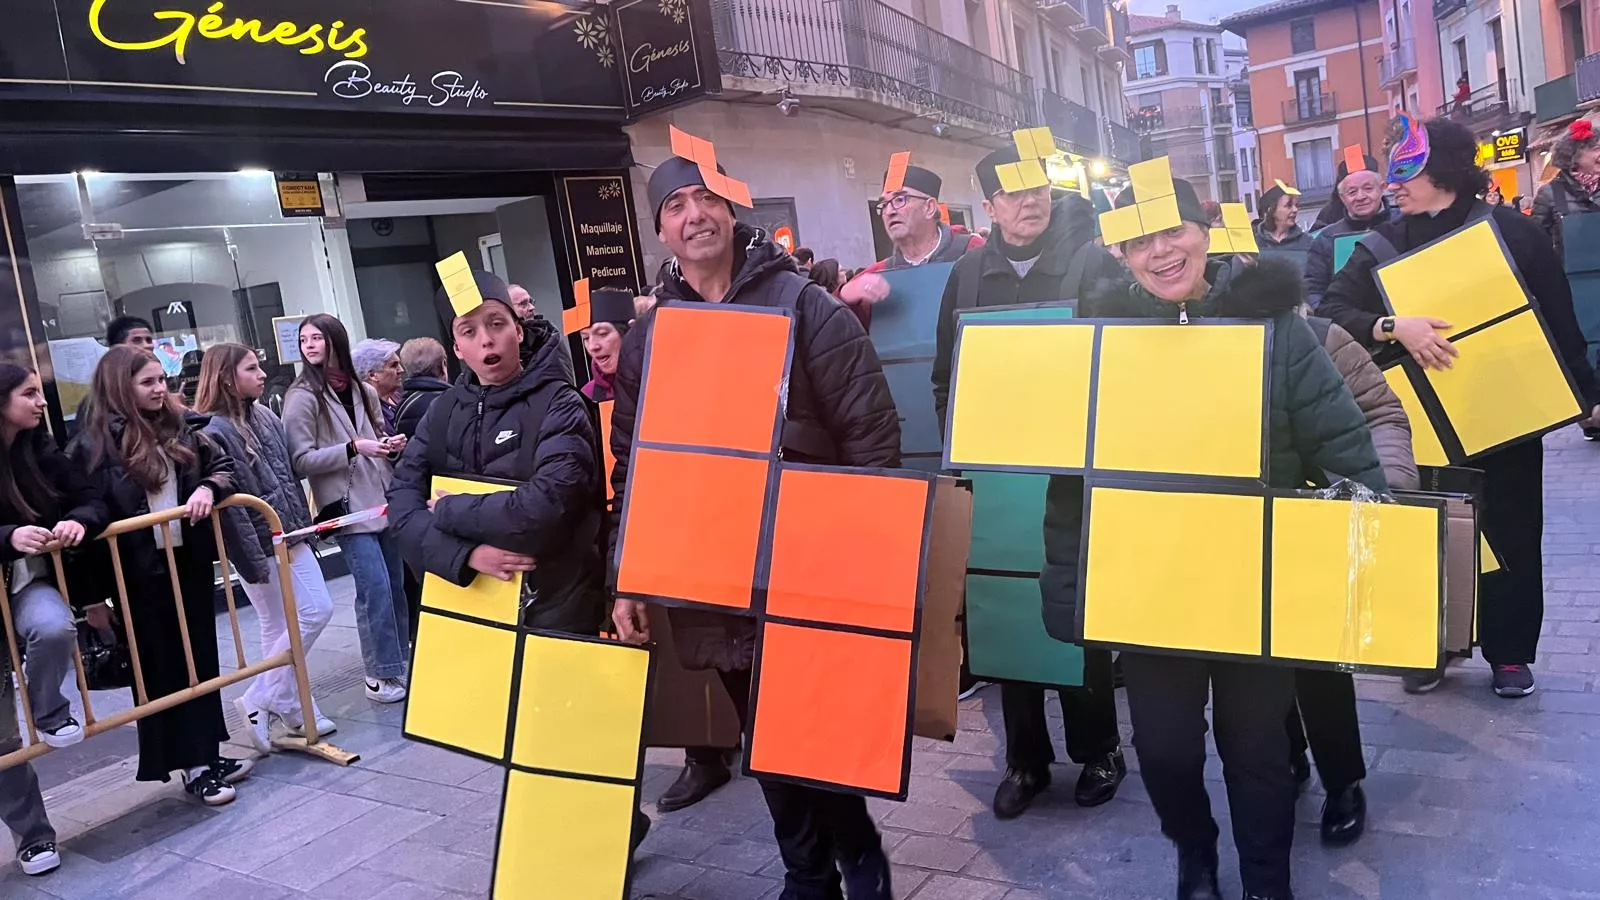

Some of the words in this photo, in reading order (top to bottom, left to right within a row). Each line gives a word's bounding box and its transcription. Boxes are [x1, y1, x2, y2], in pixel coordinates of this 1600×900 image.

[89, 0, 368, 65] Génesis
[630, 40, 690, 73] Génesis
[324, 60, 428, 105] Beauty
[428, 71, 489, 108] Studio
[1496, 134, 1519, 147] OVS
[580, 222, 623, 235] Maquillaje
[586, 244, 624, 257] Manicura
[591, 267, 626, 278] Pedicura
